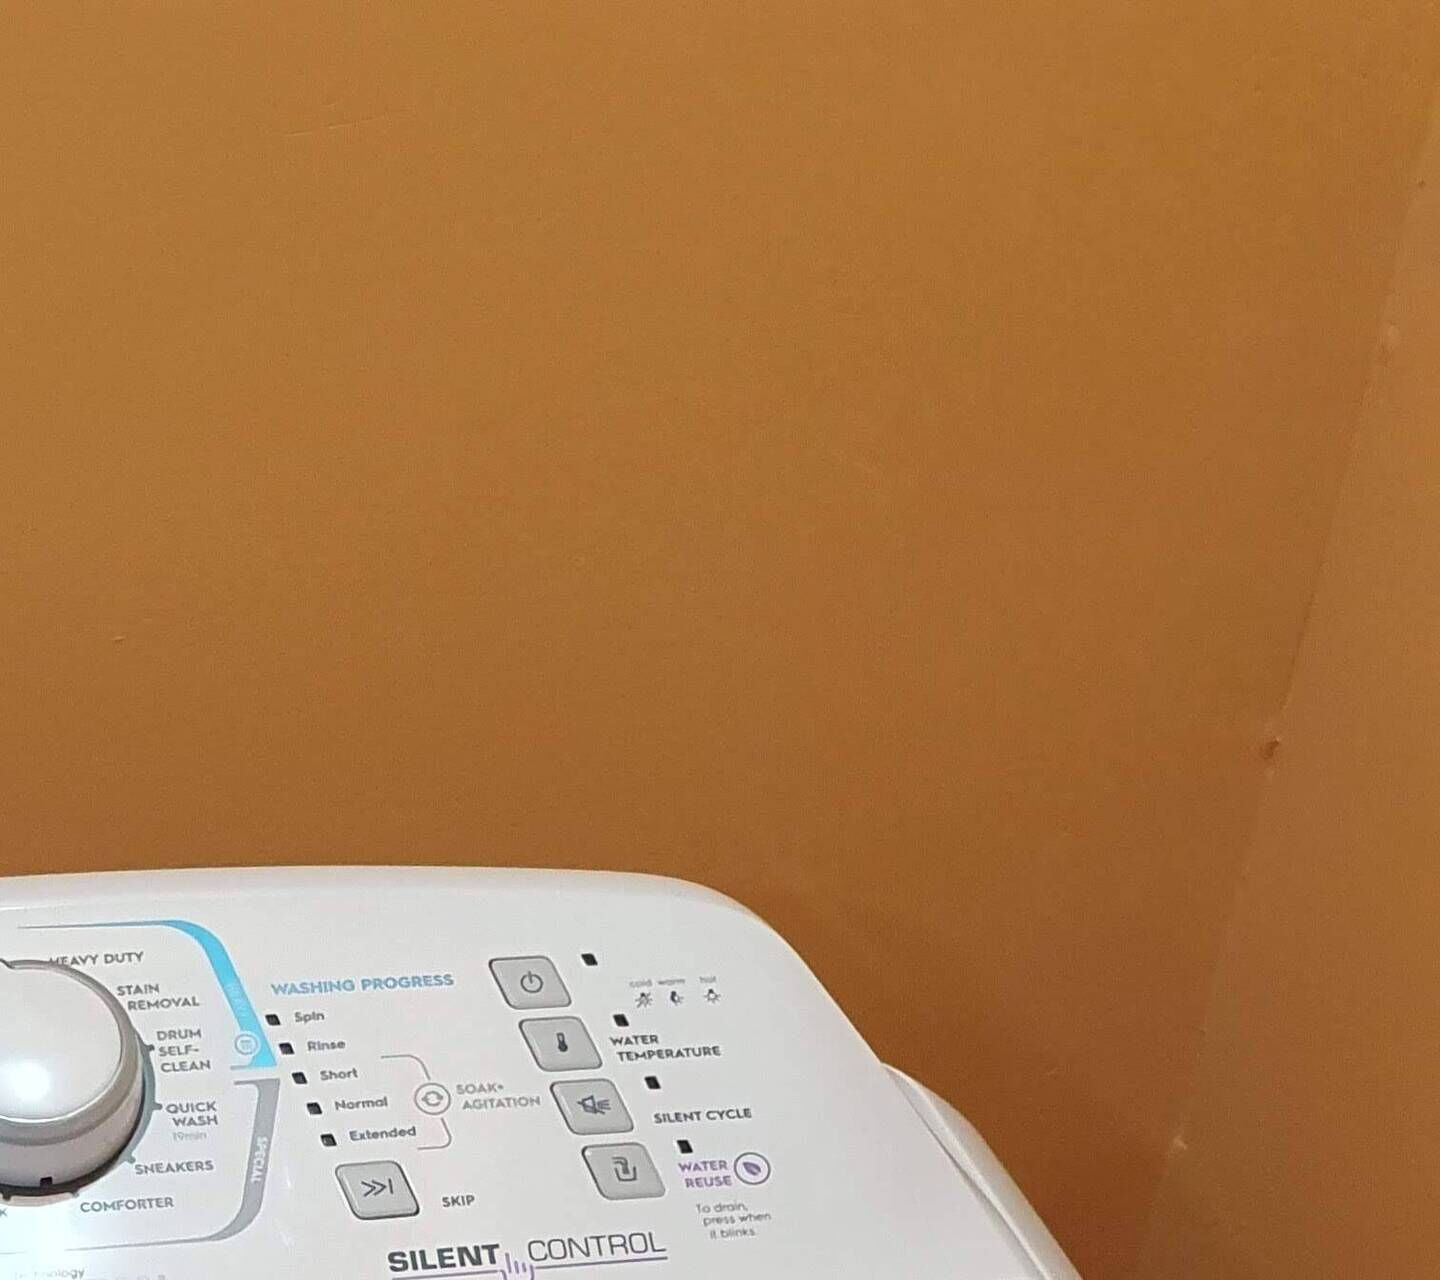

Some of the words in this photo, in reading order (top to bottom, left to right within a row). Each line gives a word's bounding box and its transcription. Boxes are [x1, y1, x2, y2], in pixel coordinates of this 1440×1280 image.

[104, 952, 143, 964] DUTY
[117, 983, 159, 996] STAIN
[271, 978, 356, 996] WASHING
[361, 973, 454, 991] PROGRESS
[127, 996, 200, 1011] REMOVAL
[294, 1009, 325, 1024] Spin
[157, 1029, 201, 1041] DRUM
[609, 1033, 659, 1048] WATER
[158, 1045, 199, 1057] SELF-
[307, 1038, 346, 1052] Rinse
[617, 1046, 721, 1063] TEMPERATURE
[161, 1060, 211, 1073] CLEAN
[320, 1067, 358, 1082] Short
[166, 1101, 217, 1114] QUICK
[334, 1096, 388, 1111] Normal
[462, 1096, 541, 1110] AGITATION
[172, 1115, 218, 1127] WASH
[653, 1109, 702, 1124] SILENT
[705, 1107, 752, 1121] CYCLE
[349, 1125, 417, 1142] Extended
[134, 1160, 214, 1175] SNEAKERS
[251, 1136, 269, 1184] SPECIAL
[678, 1158, 727, 1174] WATER
[685, 1174, 732, 1189] REUSE
[80, 1197, 174, 1213] COMFORTER
[442, 1194, 474, 1208] SKIP
[696, 1203, 711, 1214] To
[703, 1216, 736, 1227] press
[738, 1213, 771, 1223] when
[388, 1243, 500, 1273] SILENT
[527, 1231, 667, 1262] CONTROL
